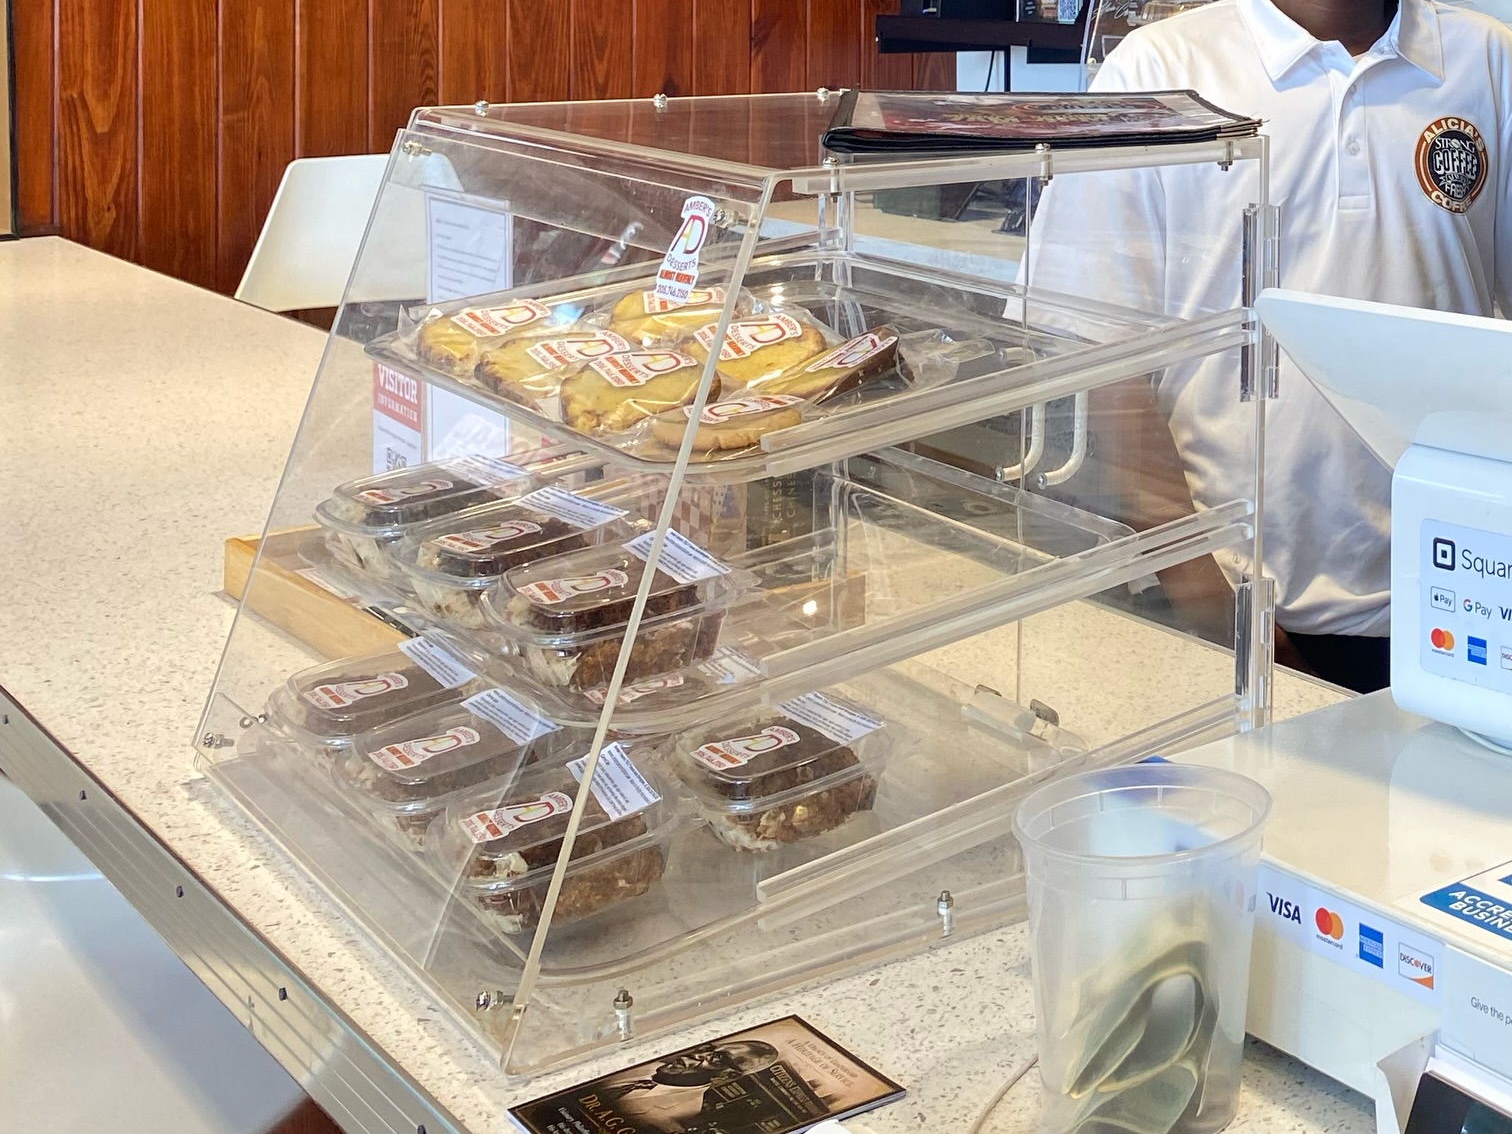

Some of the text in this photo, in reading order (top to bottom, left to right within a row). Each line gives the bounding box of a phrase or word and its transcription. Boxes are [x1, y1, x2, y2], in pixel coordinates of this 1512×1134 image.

[1423, 118, 1485, 152] ALICIA'S
[1435, 137, 1476, 154] STRONG
[1433, 148, 1478, 181] COFFEE
[684, 200, 713, 217] AMBER'S
[1430, 190, 1472, 213] COFFE
[666, 253, 697, 272] DESSERTS
[730, 324, 757, 350] DESSERTS
[774, 314, 800, 337] AMBER'S
[377, 363, 418, 405] VISITOR
[377, 392, 418, 423] INFORMATION
[772, 480, 783, 521] CHESS
[1439, 594, 1453, 607] Pay
[1475, 601, 1493, 620] Pay
[1266, 891, 1302, 925] VISA
[1315, 933, 1344, 950] mastercard
[1399, 951, 1433, 975] DISCOVER
[1470, 996, 1490, 1015] Give
[1490, 1005, 1505, 1021] the
[578, 1093, 601, 1112] DR.
